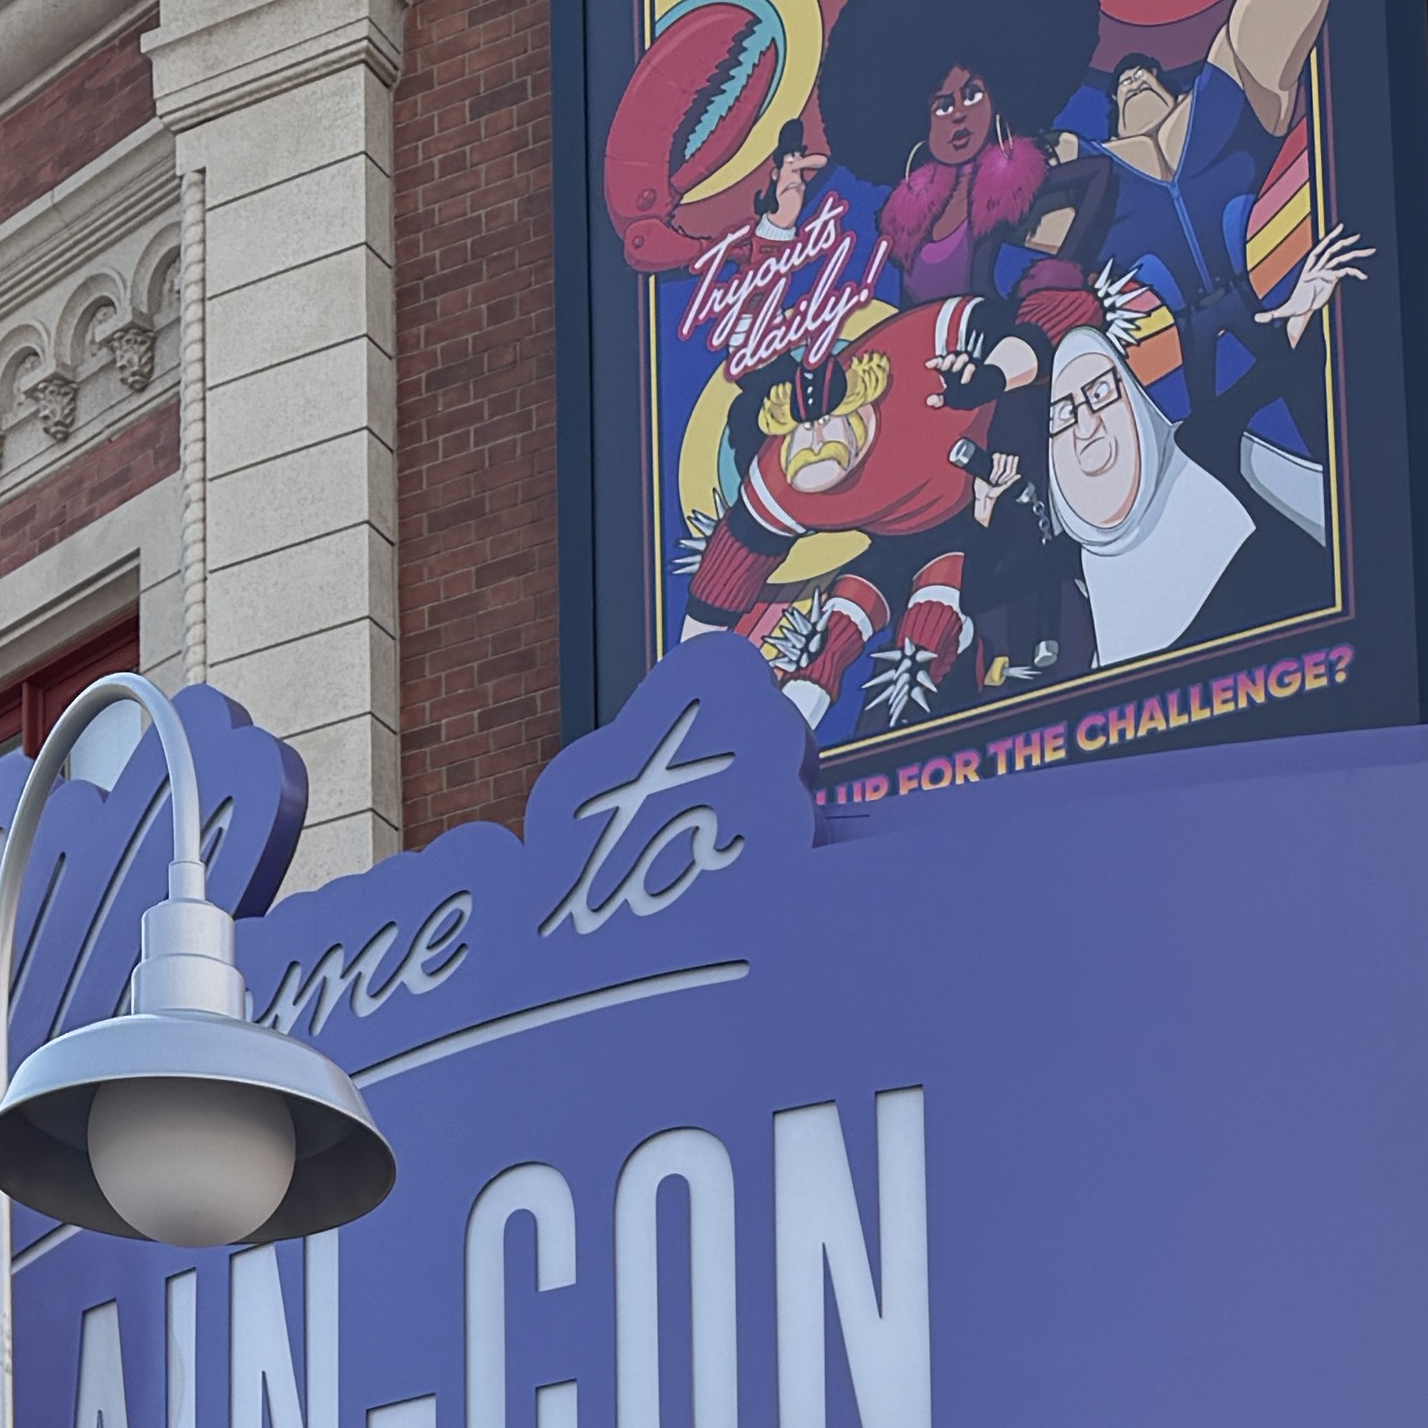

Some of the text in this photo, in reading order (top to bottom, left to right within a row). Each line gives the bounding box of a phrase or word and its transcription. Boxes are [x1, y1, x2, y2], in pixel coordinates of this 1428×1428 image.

[680, 194, 846, 348] Tryouts
[728, 236, 889, 377] daily!
[898, 750, 981, 796] FOR
[987, 720, 1068, 777] THE
[1074, 644, 1356, 753] CHALLENGE?
[538, 698, 746, 936] to
